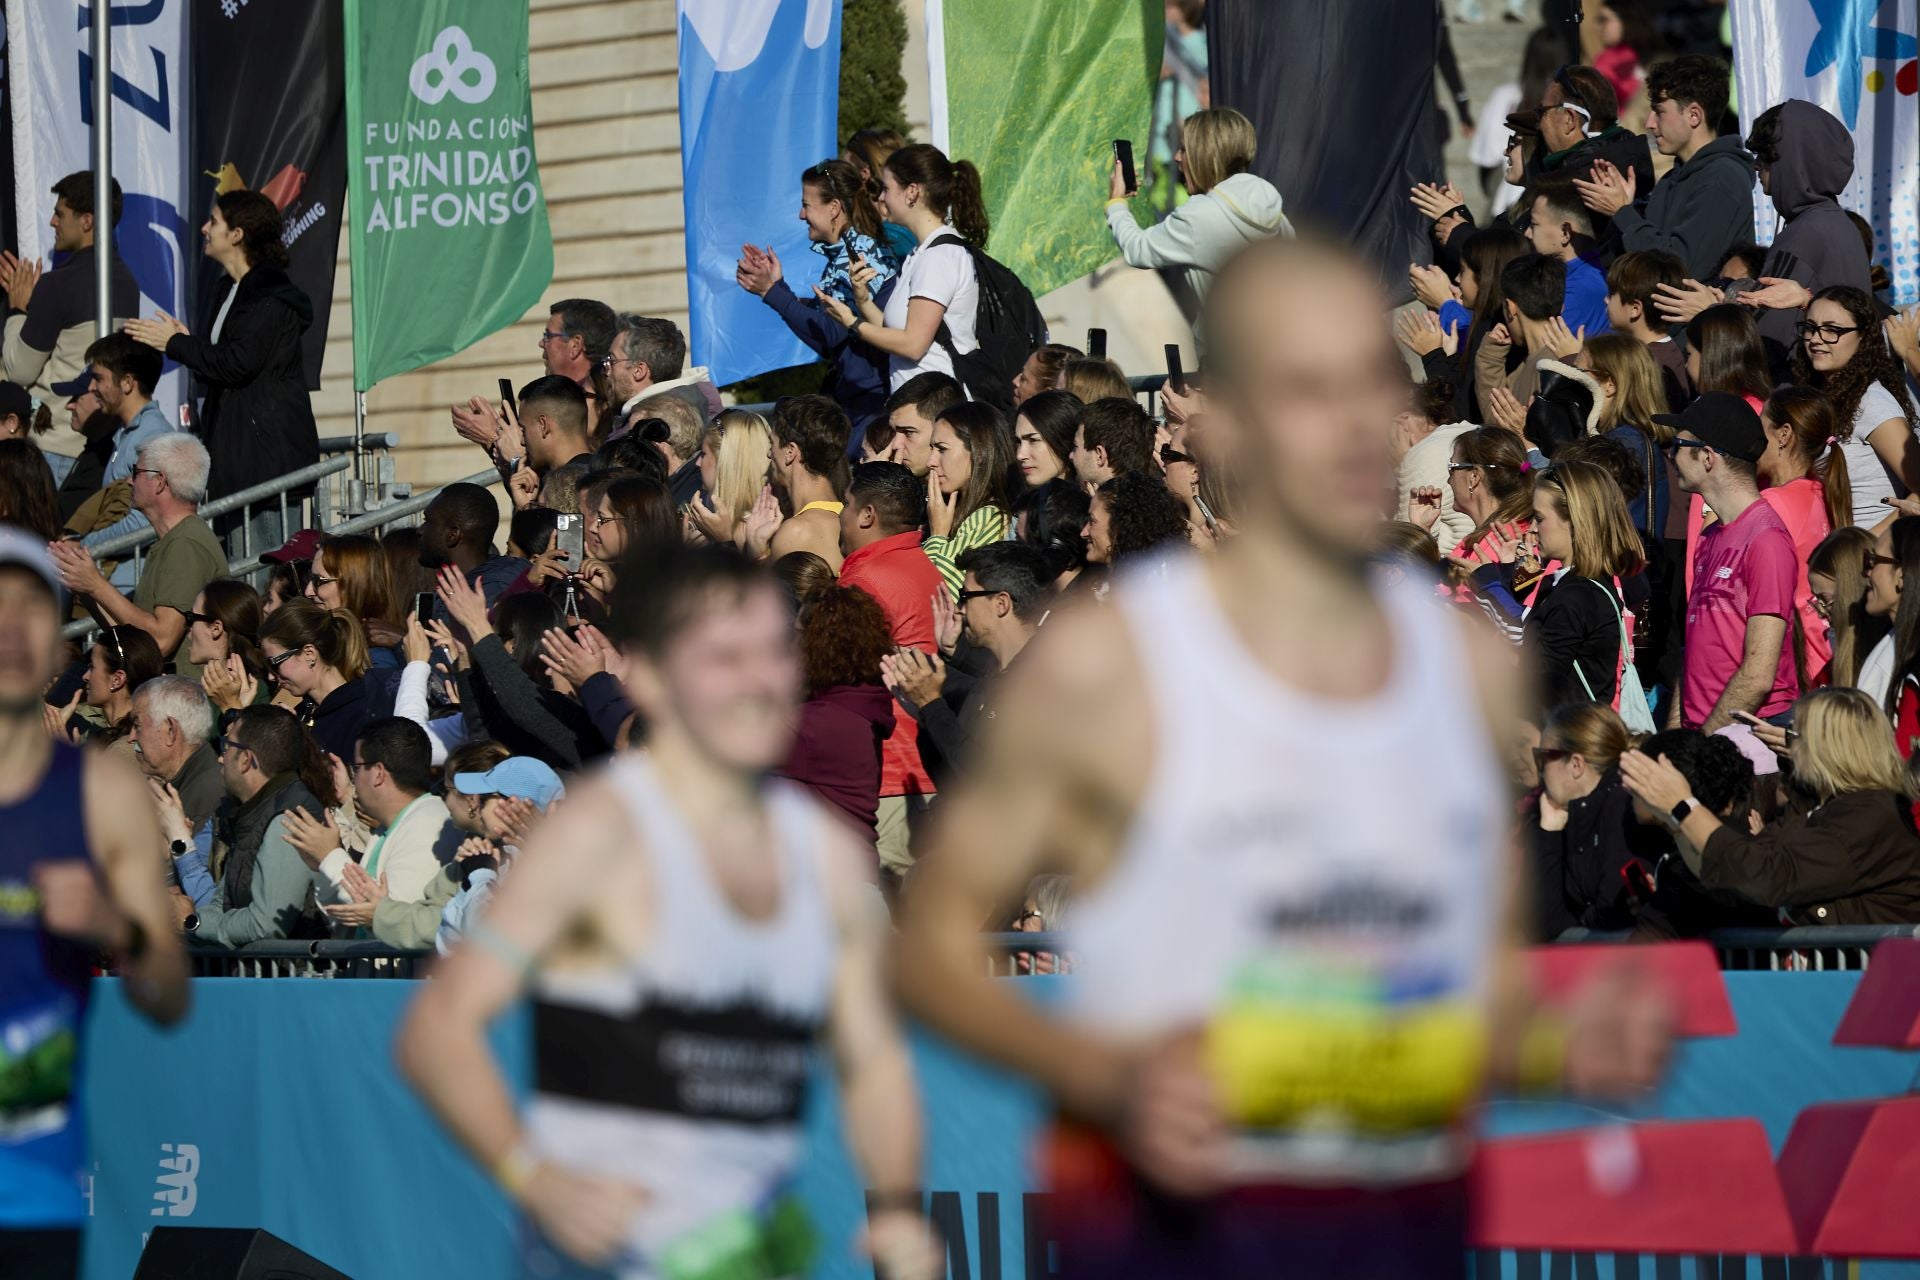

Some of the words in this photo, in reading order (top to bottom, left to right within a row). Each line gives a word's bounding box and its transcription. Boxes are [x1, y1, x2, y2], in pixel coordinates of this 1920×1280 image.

[366, 113, 528, 145] FUNDACIÓN
[364, 146, 532, 192] TRINIDAD
[366, 181, 537, 234] ALFONSO
